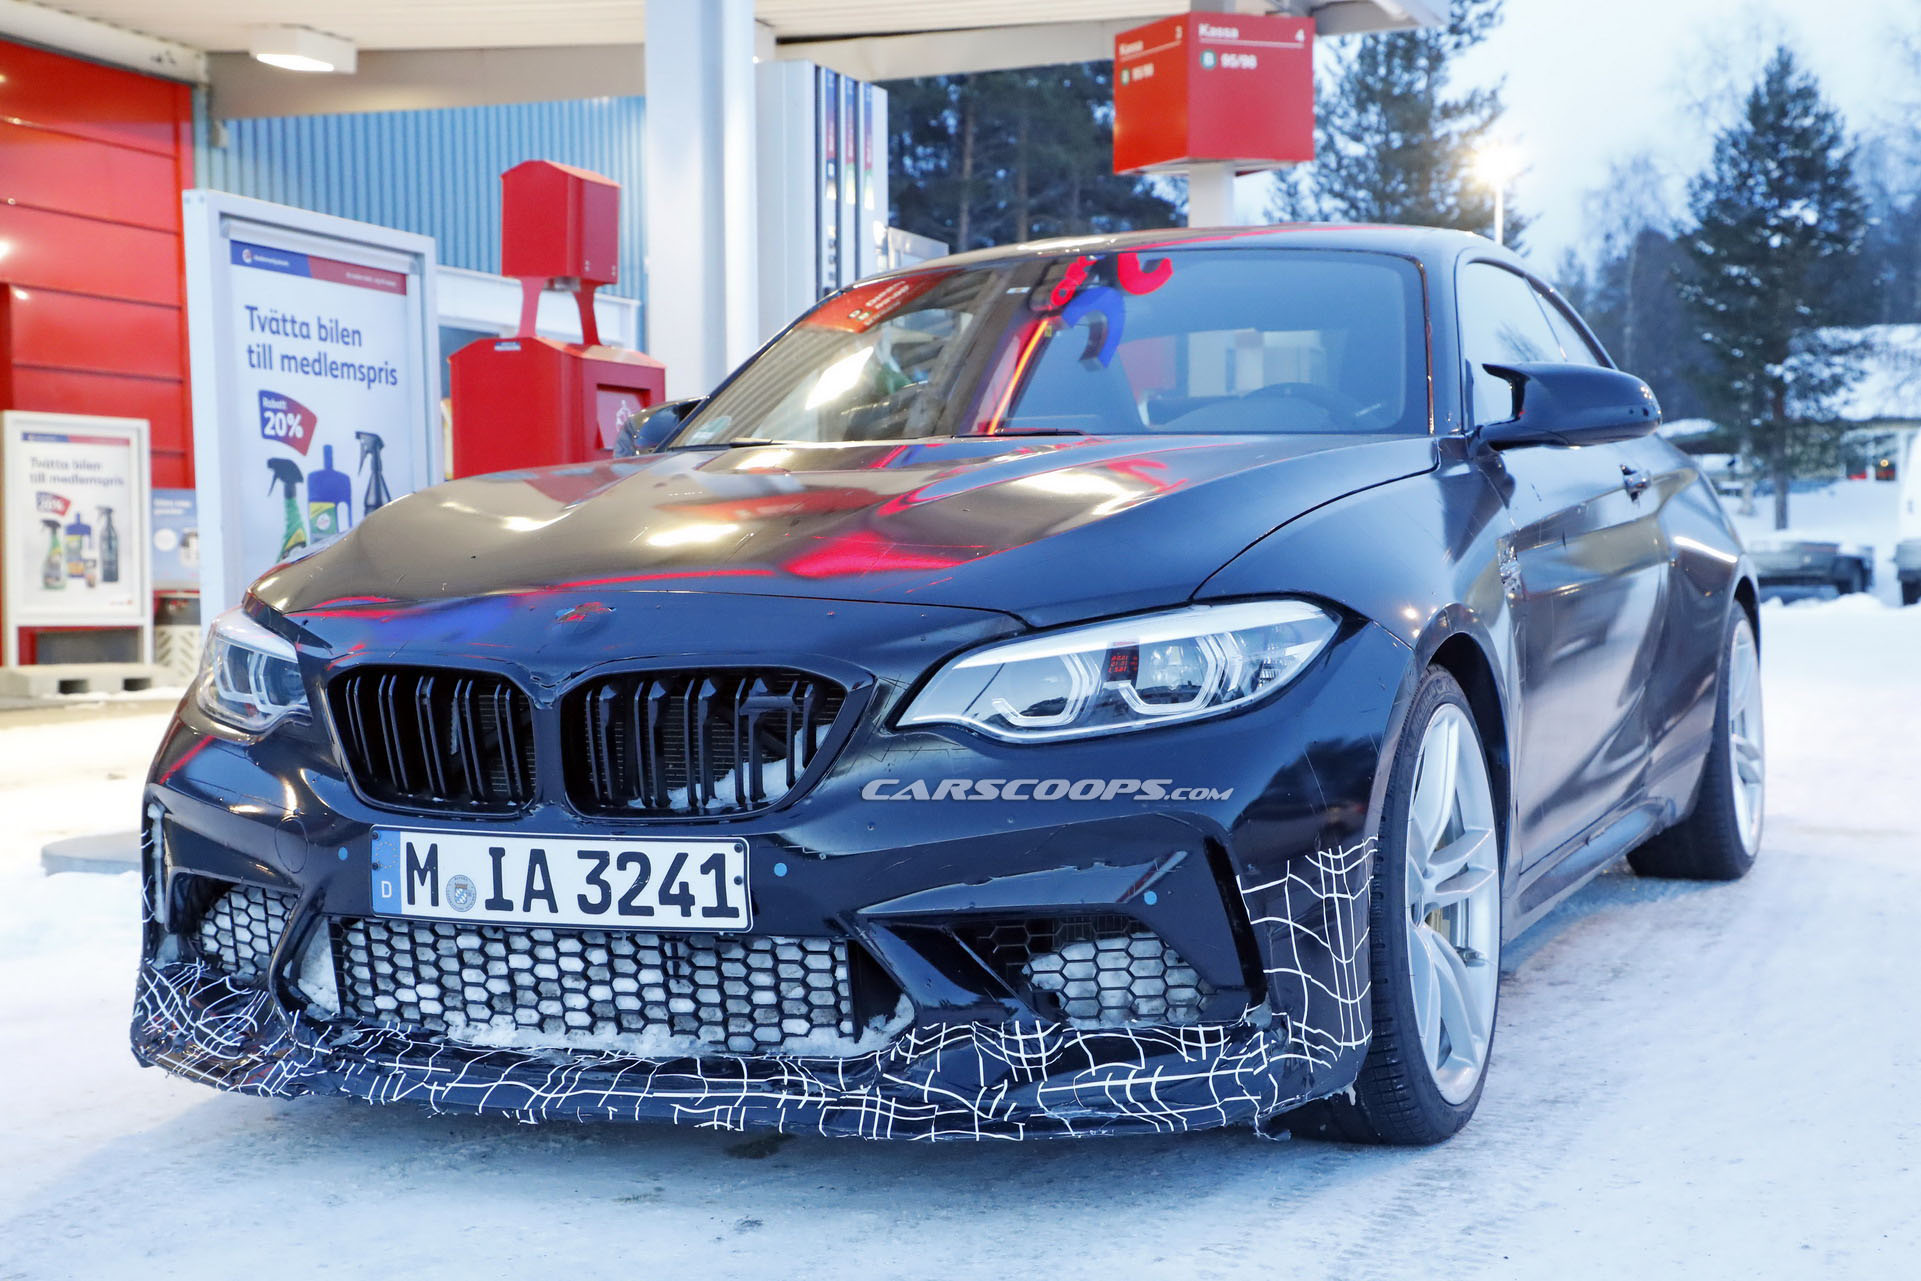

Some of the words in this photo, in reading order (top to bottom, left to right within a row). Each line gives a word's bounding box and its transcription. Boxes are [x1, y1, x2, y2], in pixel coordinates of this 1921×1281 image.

[245, 304, 312, 341] Tvätta
[318, 315, 363, 348] bilen
[247, 343, 274, 370] till
[281, 352, 399, 391] medlemspris
[263, 411, 304, 439] 20%
[381, 881, 392, 898] D
[406, 842, 439, 907] M
[485, 846, 559, 914] IA
[577, 850, 740, 919] 3241
